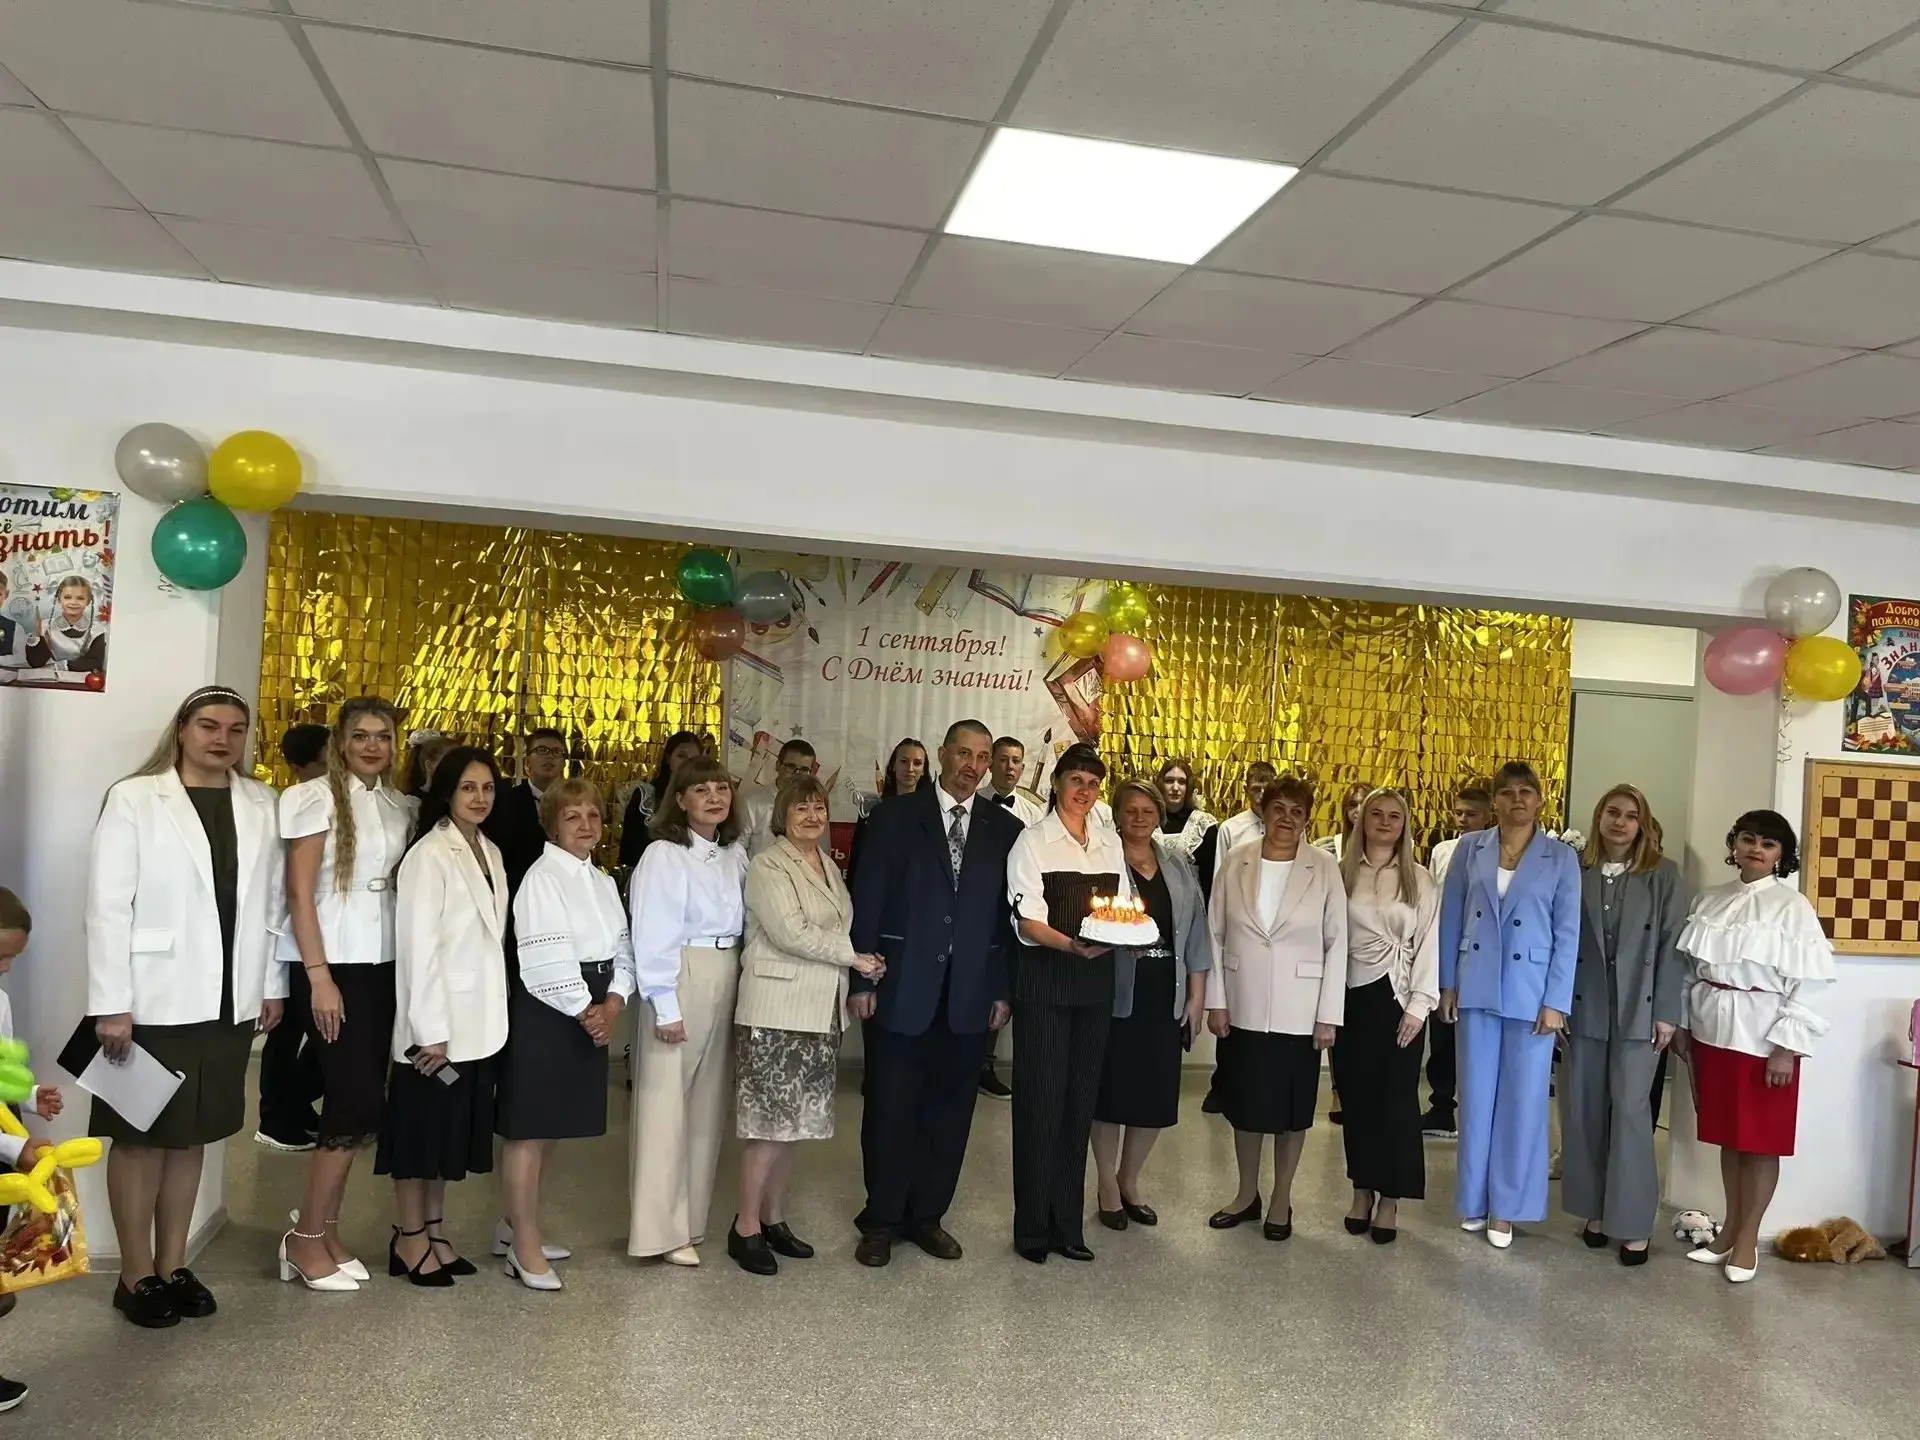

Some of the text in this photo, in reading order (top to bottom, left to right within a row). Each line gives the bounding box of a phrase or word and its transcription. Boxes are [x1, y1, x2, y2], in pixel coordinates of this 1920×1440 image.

[0, 520, 111, 563] знать!
[856, 626, 1007, 662] 1 сентября!
[821, 655, 1033, 692] С Днём знаний!
